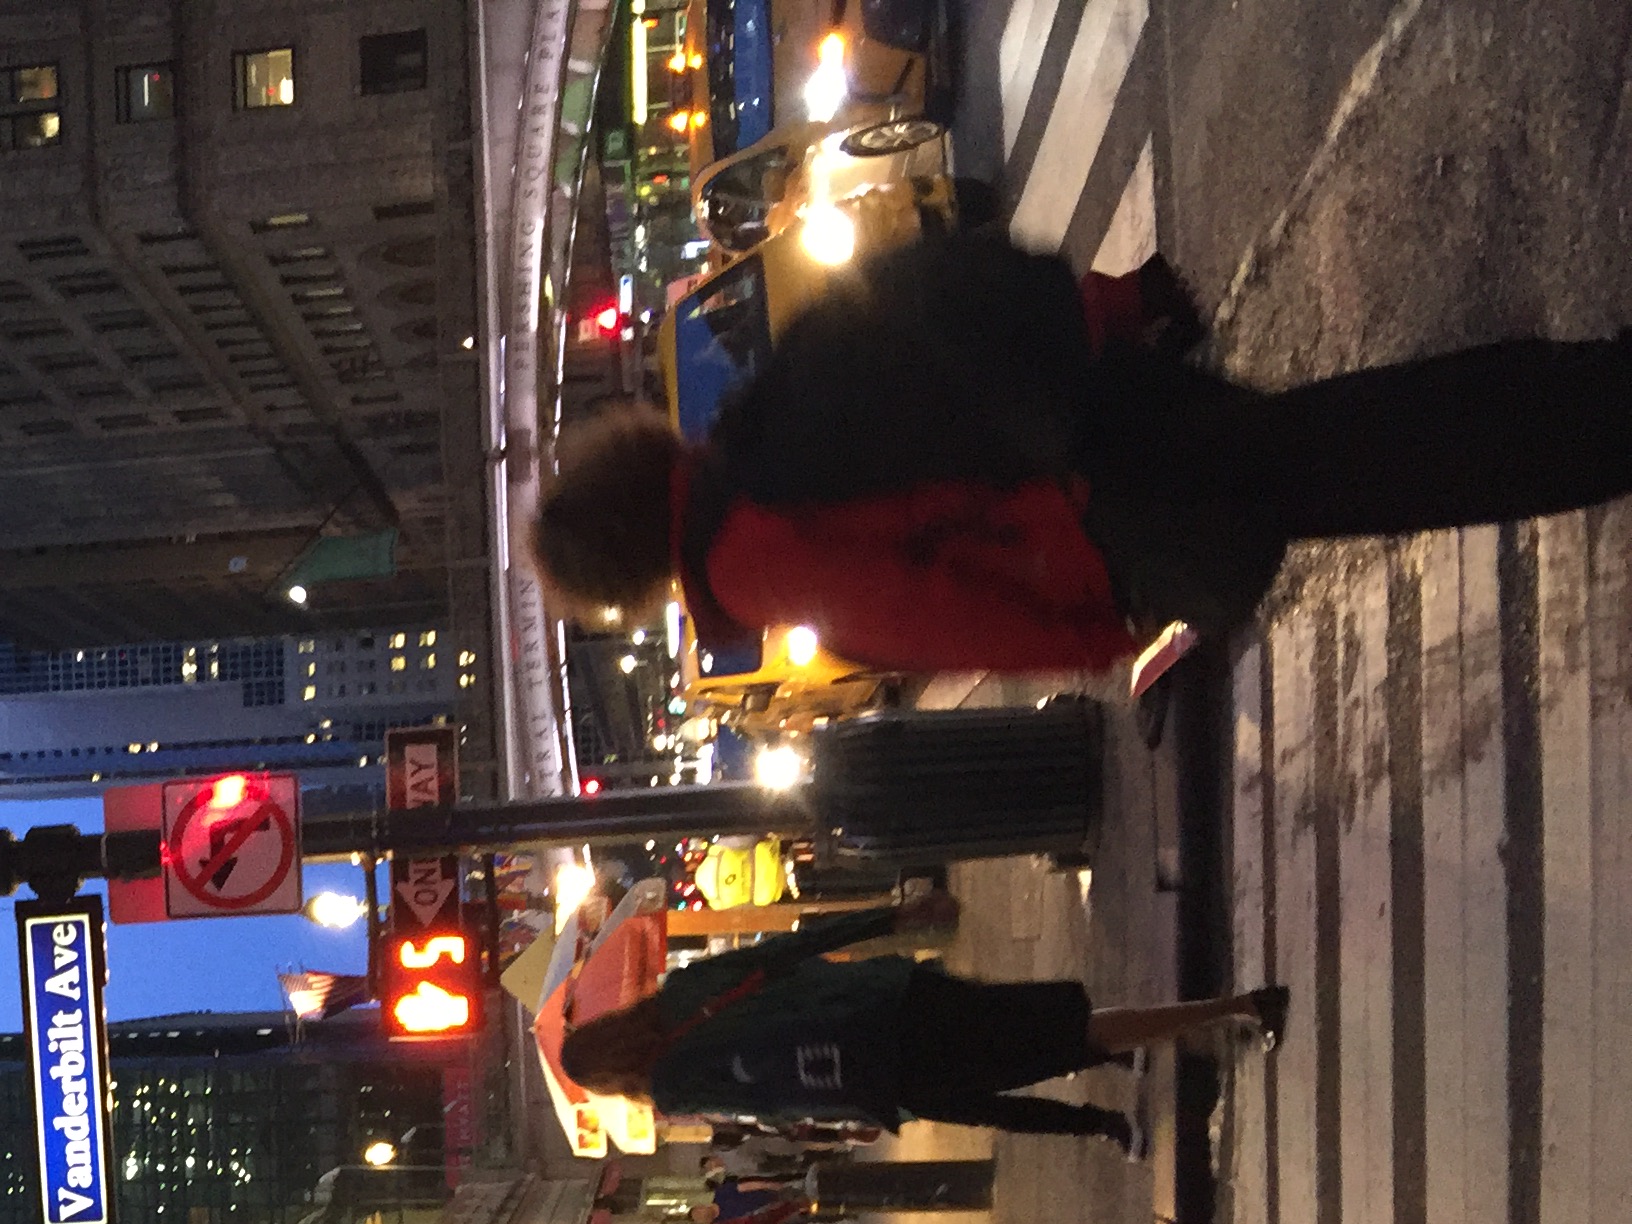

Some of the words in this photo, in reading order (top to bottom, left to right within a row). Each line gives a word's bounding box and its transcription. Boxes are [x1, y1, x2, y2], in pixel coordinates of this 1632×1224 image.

[536, 1, 560, 61] PLA
[522, 82, 550, 200] SQUARE
[512, 220, 535, 372] PERSHING
[516, 578, 543, 692] TERMIN
[530, 711, 555, 799] NTRAL
[44, 922, 81, 1001] Ave
[398, 934, 465, 969] 5
[46, 1009, 95, 1222] Vanderbilt
